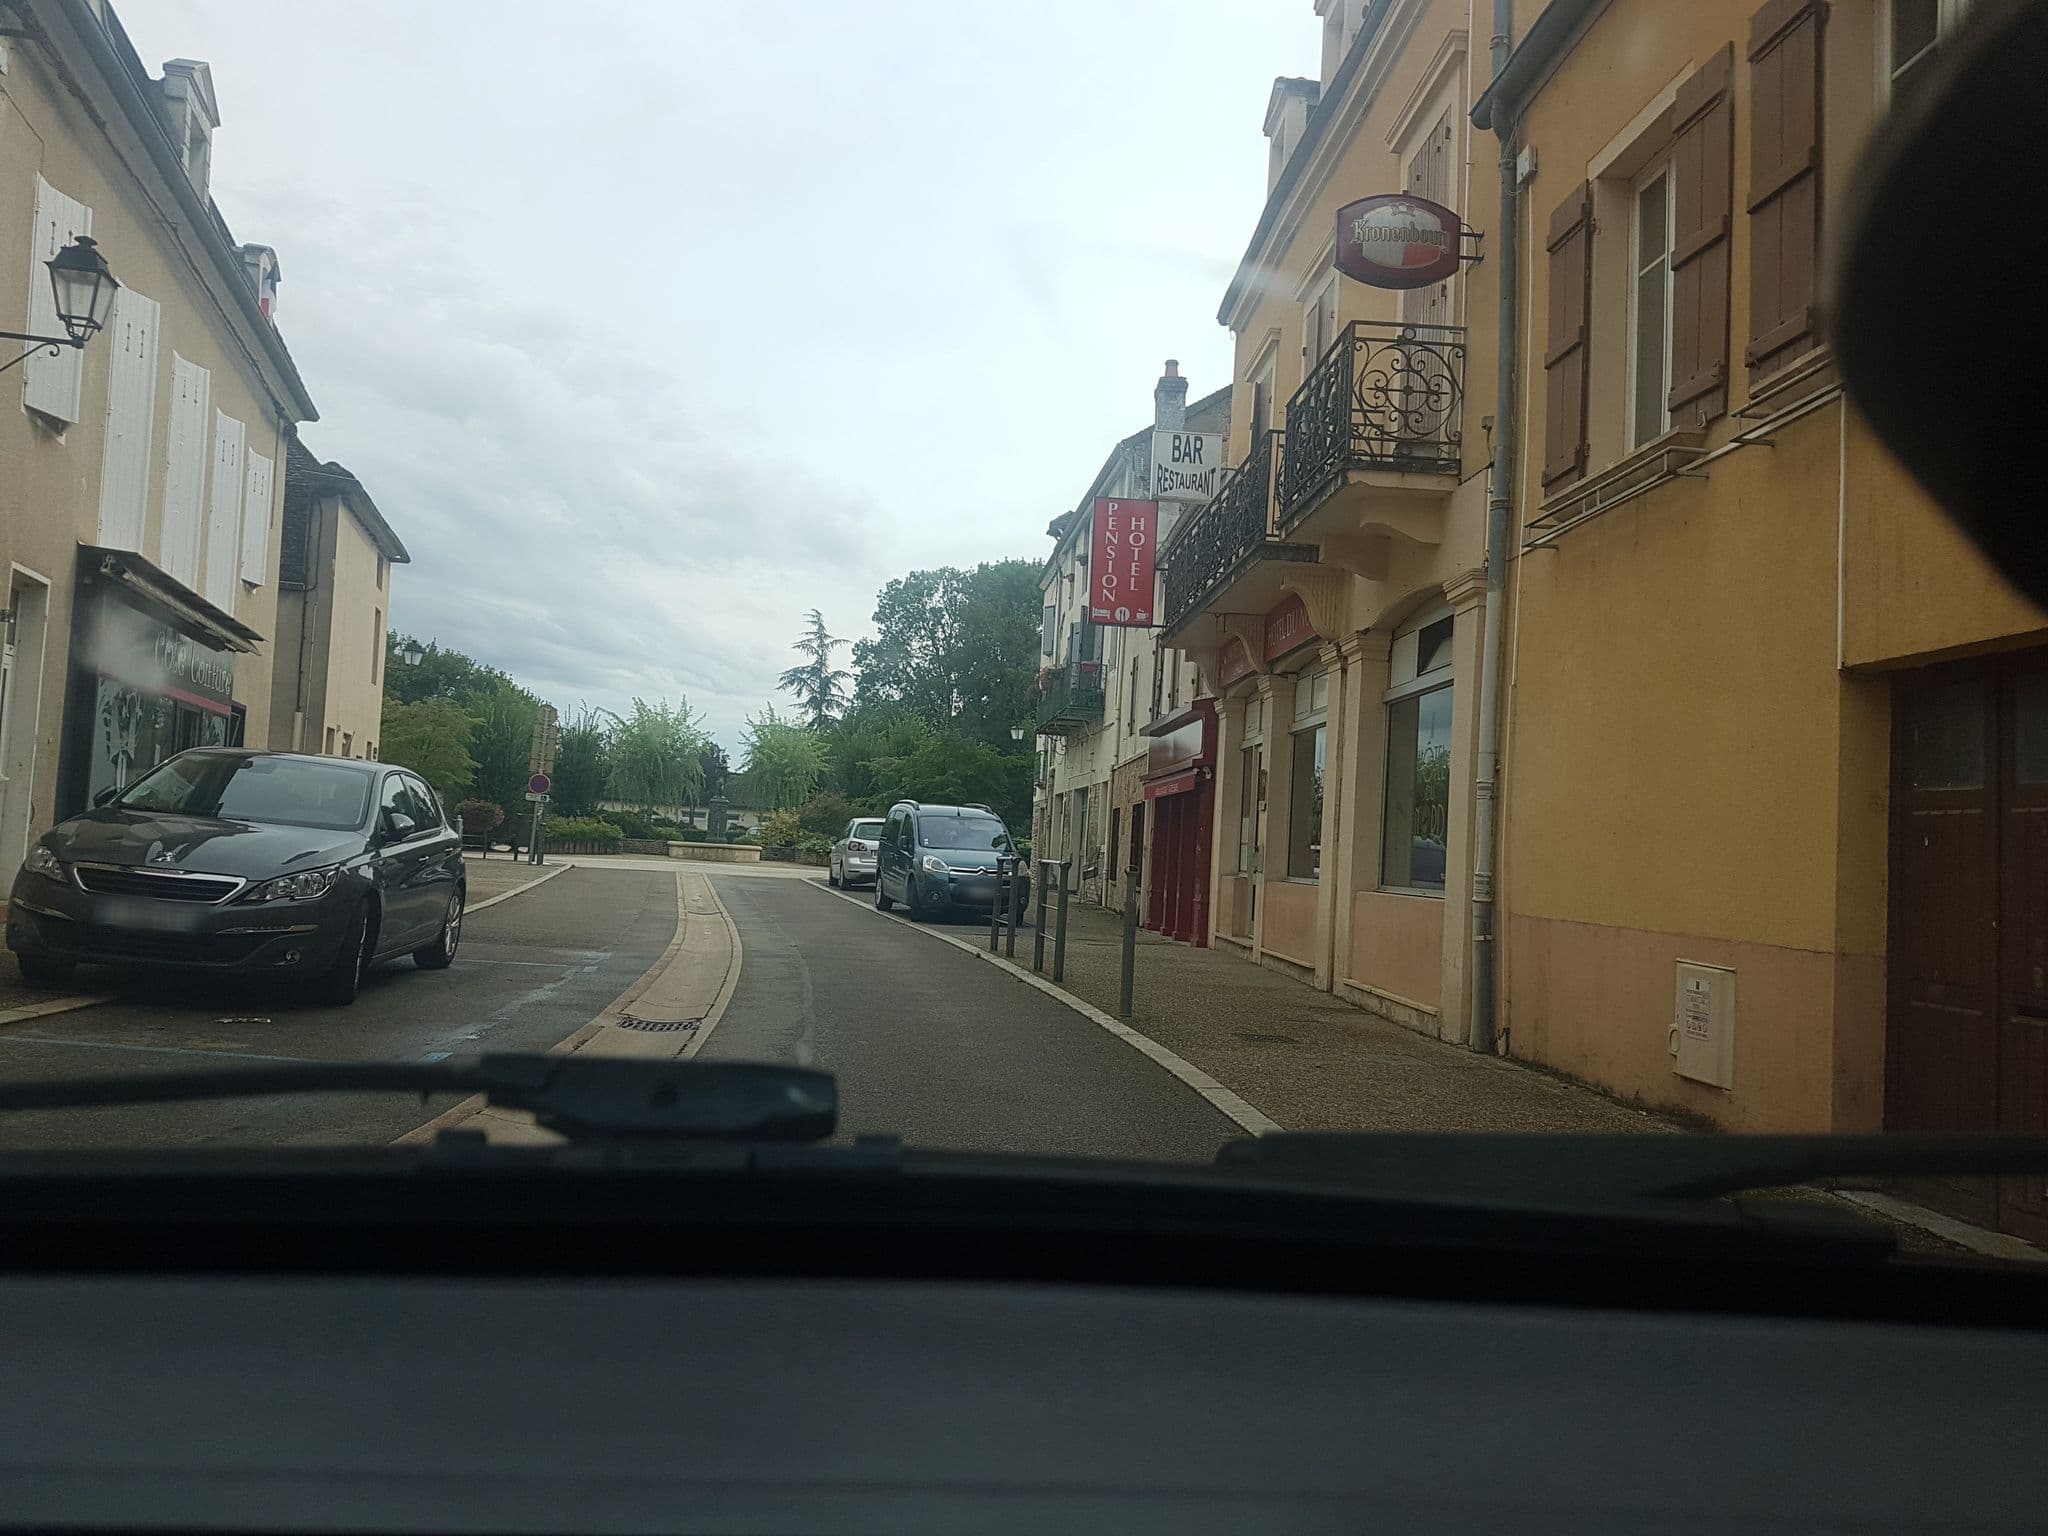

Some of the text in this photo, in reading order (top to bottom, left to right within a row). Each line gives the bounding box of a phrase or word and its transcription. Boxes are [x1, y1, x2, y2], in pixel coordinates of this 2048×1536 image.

[1171, 434, 1204, 465] BAR
[1157, 463, 1217, 499] RESTAURANT
[1101, 502, 1120, 603] PENSION
[1128, 516, 1146, 592] HOTEL
